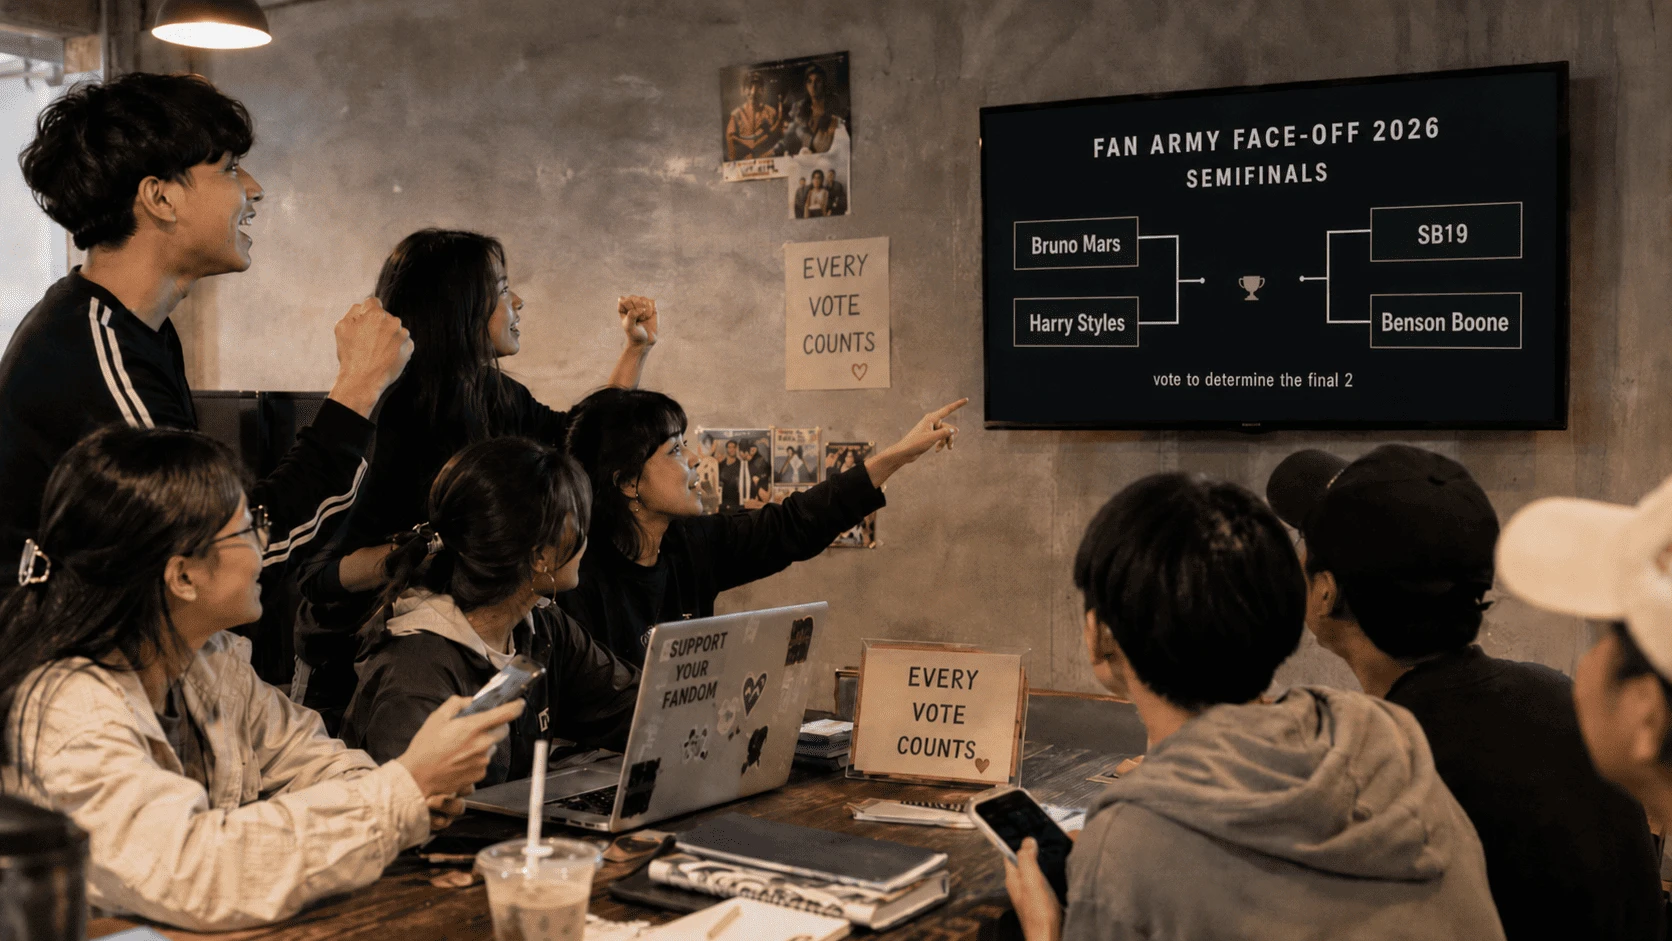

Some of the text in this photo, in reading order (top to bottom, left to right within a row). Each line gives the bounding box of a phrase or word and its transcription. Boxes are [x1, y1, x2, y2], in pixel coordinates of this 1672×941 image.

[1093, 117, 1439, 158] FAN ARMY FACE-OFF 2026
[1186, 163, 1328, 189] SEMIFINALS
[1031, 235, 1121, 255] Bruno Mars
[1417, 223, 1468, 245] SB19
[803, 253, 868, 279] EVERY
[808, 294, 860, 317] VOTE
[1029, 313, 1126, 337] Harry Styles
[1381, 312, 1509, 332] Benson Boone
[803, 331, 876, 355] COUNTS
[1153, 372, 1353, 388] vote to determine the final 2
[669, 631, 728, 658] SUPPORT
[676, 660, 709, 682] YOUR
[908, 666, 979, 691] EVERY
[662, 681, 718, 709] FANDOM
[912, 702, 966, 725] VOTE
[897, 735, 976, 760] COUNTS
